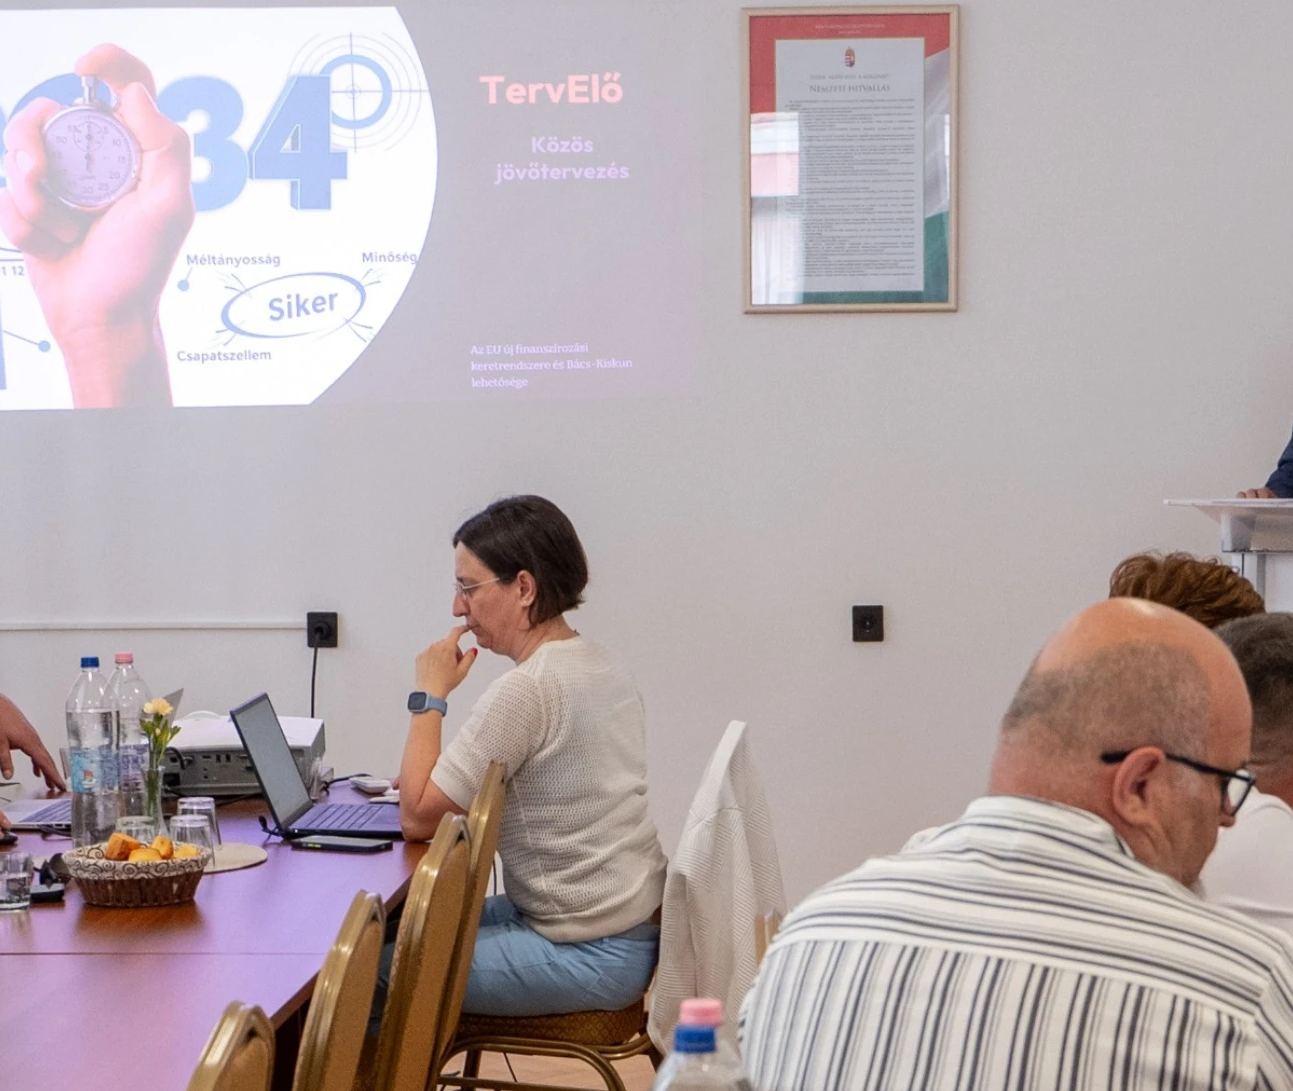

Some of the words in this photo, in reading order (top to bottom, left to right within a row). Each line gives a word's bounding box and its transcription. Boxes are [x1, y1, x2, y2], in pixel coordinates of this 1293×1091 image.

[478, 71, 624, 105] TervElő
[531, 136, 595, 153] Közös
[494, 161, 630, 185] jövőtervezés
[186, 253, 281, 268] Méltányosság
[361, 250, 418, 266] Minőség
[12, 265, 25, 276] 12
[268, 291, 339, 322] Siker
[176, 349, 272, 364] Csapatszellem
[470, 345, 485, 355] Az
[486, 344, 502, 355] EU
[503, 344, 515, 357] új
[470, 359, 551, 371] keretrendszere
[552, 358, 565, 370] és
[566, 357, 634, 369] Bács-Kiskun
